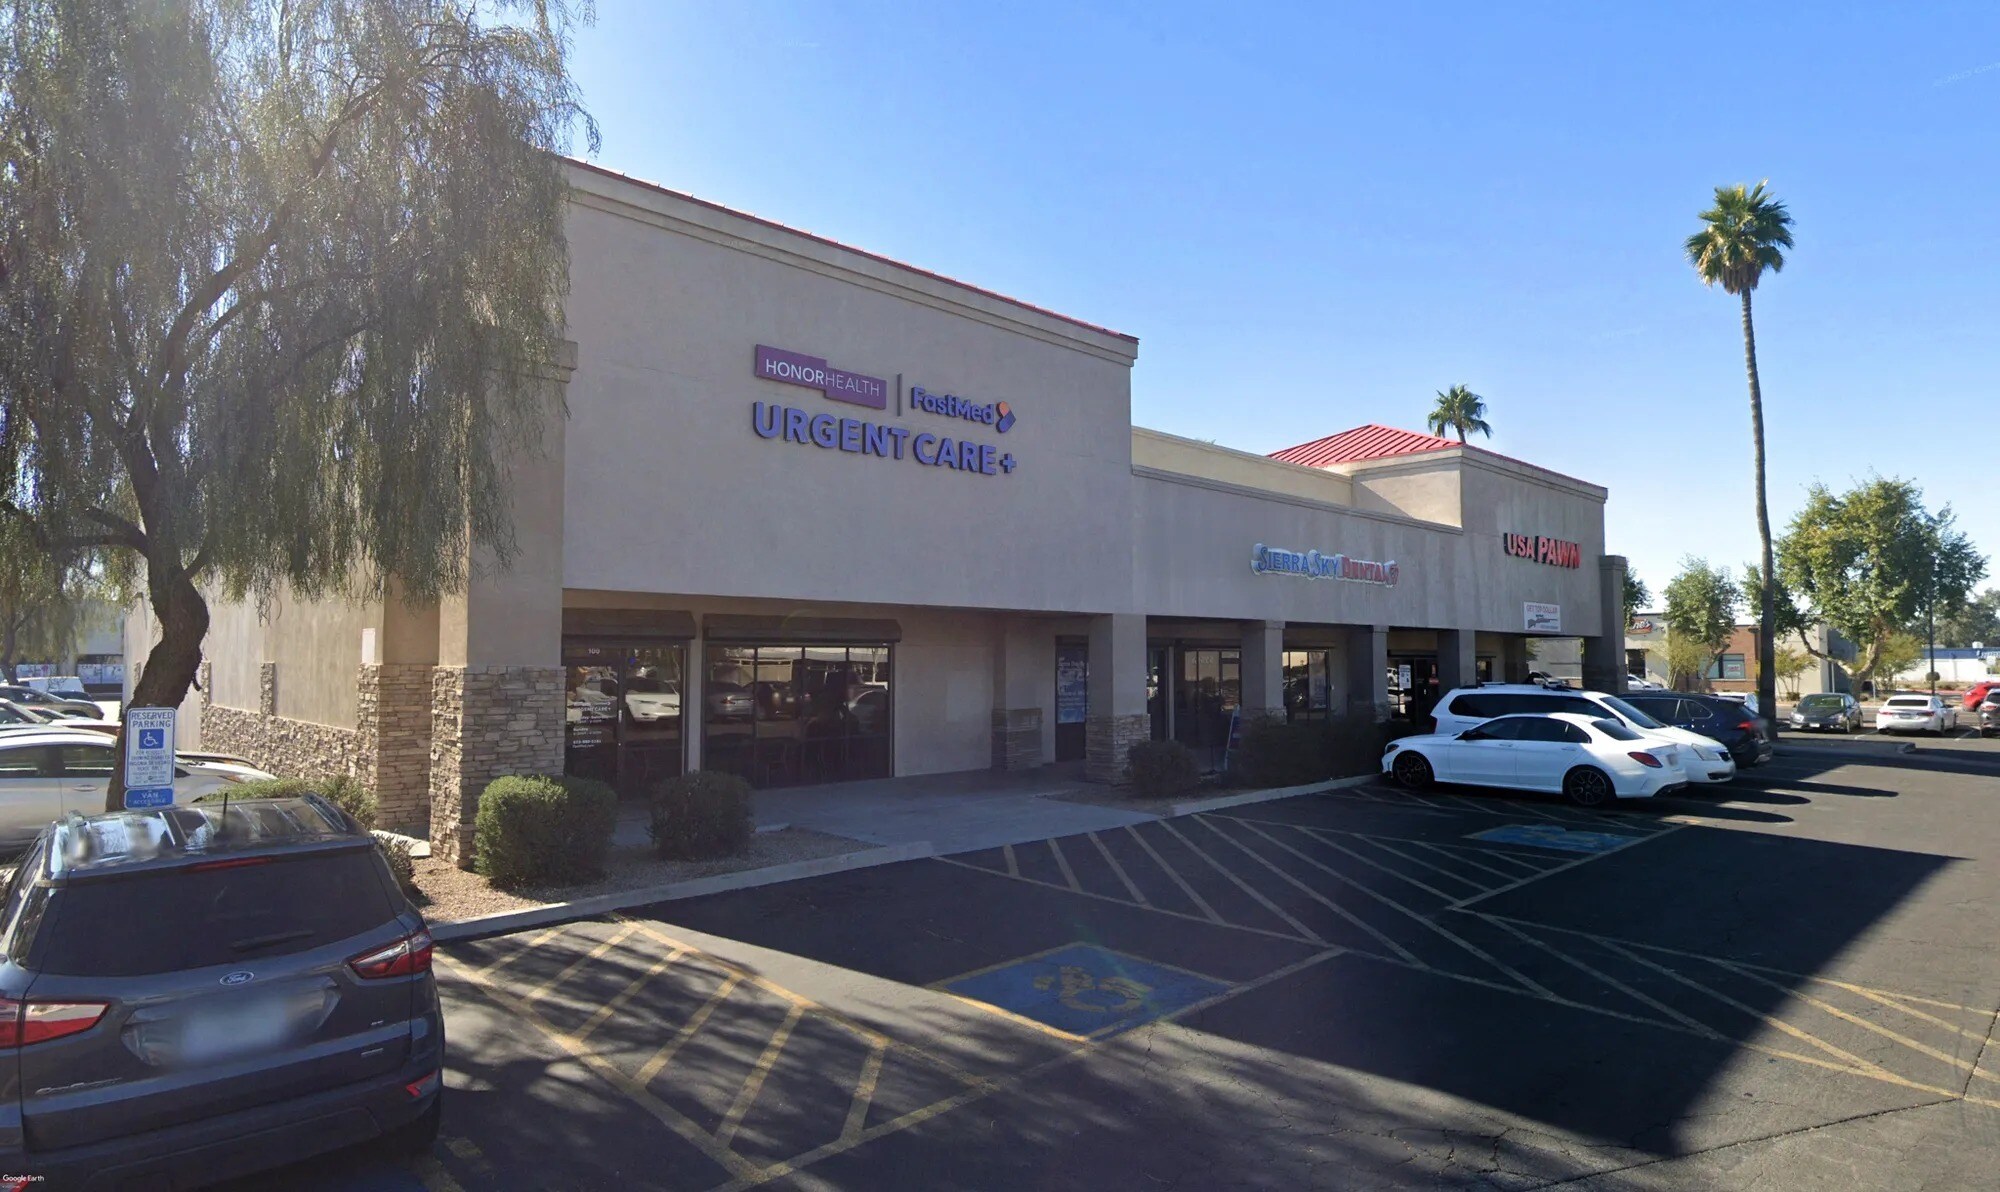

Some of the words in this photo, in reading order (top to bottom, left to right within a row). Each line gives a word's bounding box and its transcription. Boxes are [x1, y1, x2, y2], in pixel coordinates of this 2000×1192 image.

[765, 358, 880, 397] HONORHEALTH
[911, 386, 995, 425] FastMed
[753, 401, 910, 460] URGENT
[1257, 546, 1310, 573] SIERRA
[1312, 553, 1339, 577] SKY
[1341, 556, 1389, 583] DENTAL
[1504, 532, 1535, 558] USA
[1535, 536, 1582, 569] PAWN
[131, 711, 173, 720] RESERVED
[132, 720, 171, 728] PARKING
